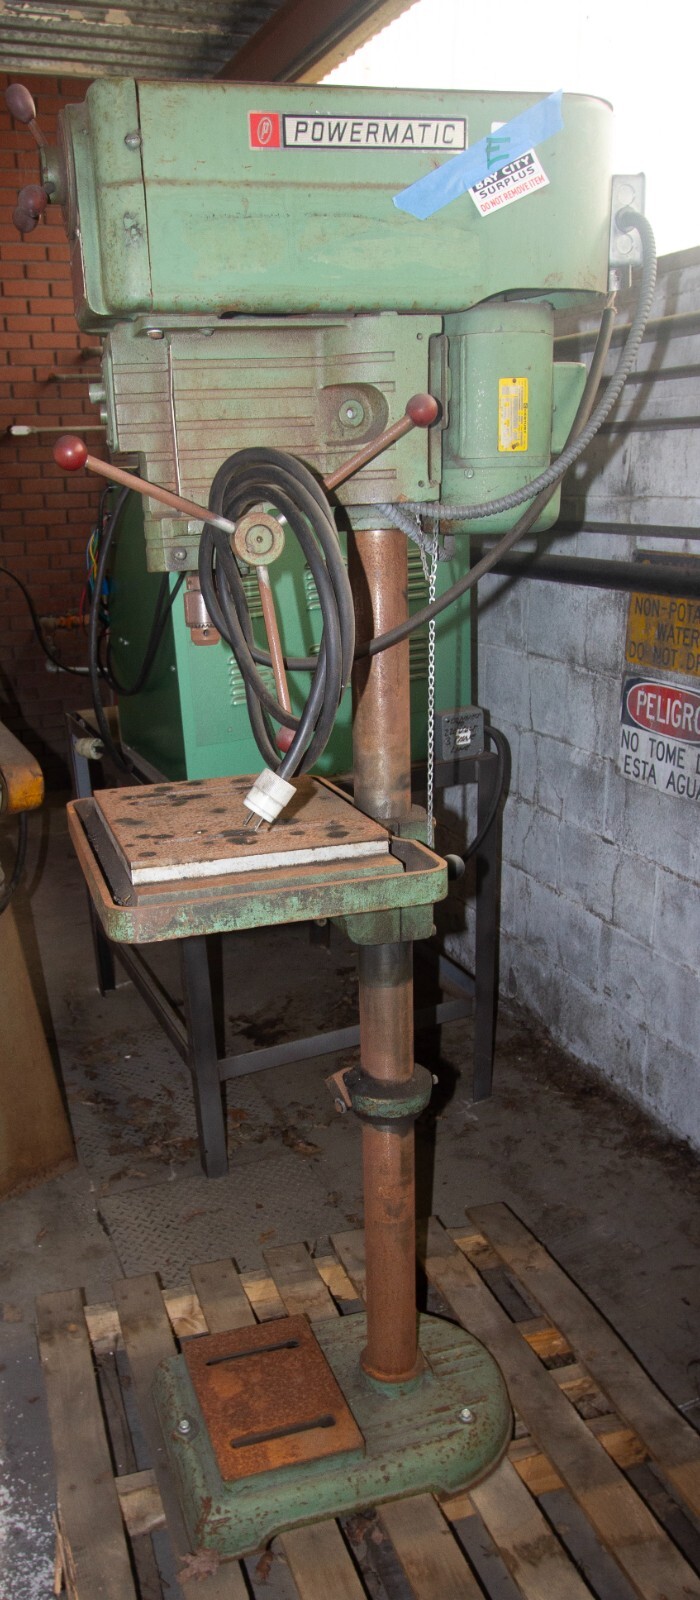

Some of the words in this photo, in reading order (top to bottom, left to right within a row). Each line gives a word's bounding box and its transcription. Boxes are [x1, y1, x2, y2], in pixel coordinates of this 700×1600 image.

[294, 121, 455, 144] POWERMATIC
[486, 137, 510, 169] E
[475, 171, 498, 188] BAY
[501, 155, 530, 175] CITY
[479, 166, 535, 199] SURPLUS
[480, 202, 490, 212] DO
[490, 196, 504, 208] NOT
[503, 182, 530, 201] REMOVE
[529, 175, 545, 189] ITEM
[656, 623, 700, 648] WATER
[628, 641, 645, 660] DO
[653, 645, 678, 667] NOT
[621, 729, 639, 752] NO
[649, 738, 686, 769] TOME
[624, 755, 656, 784] ESTA
